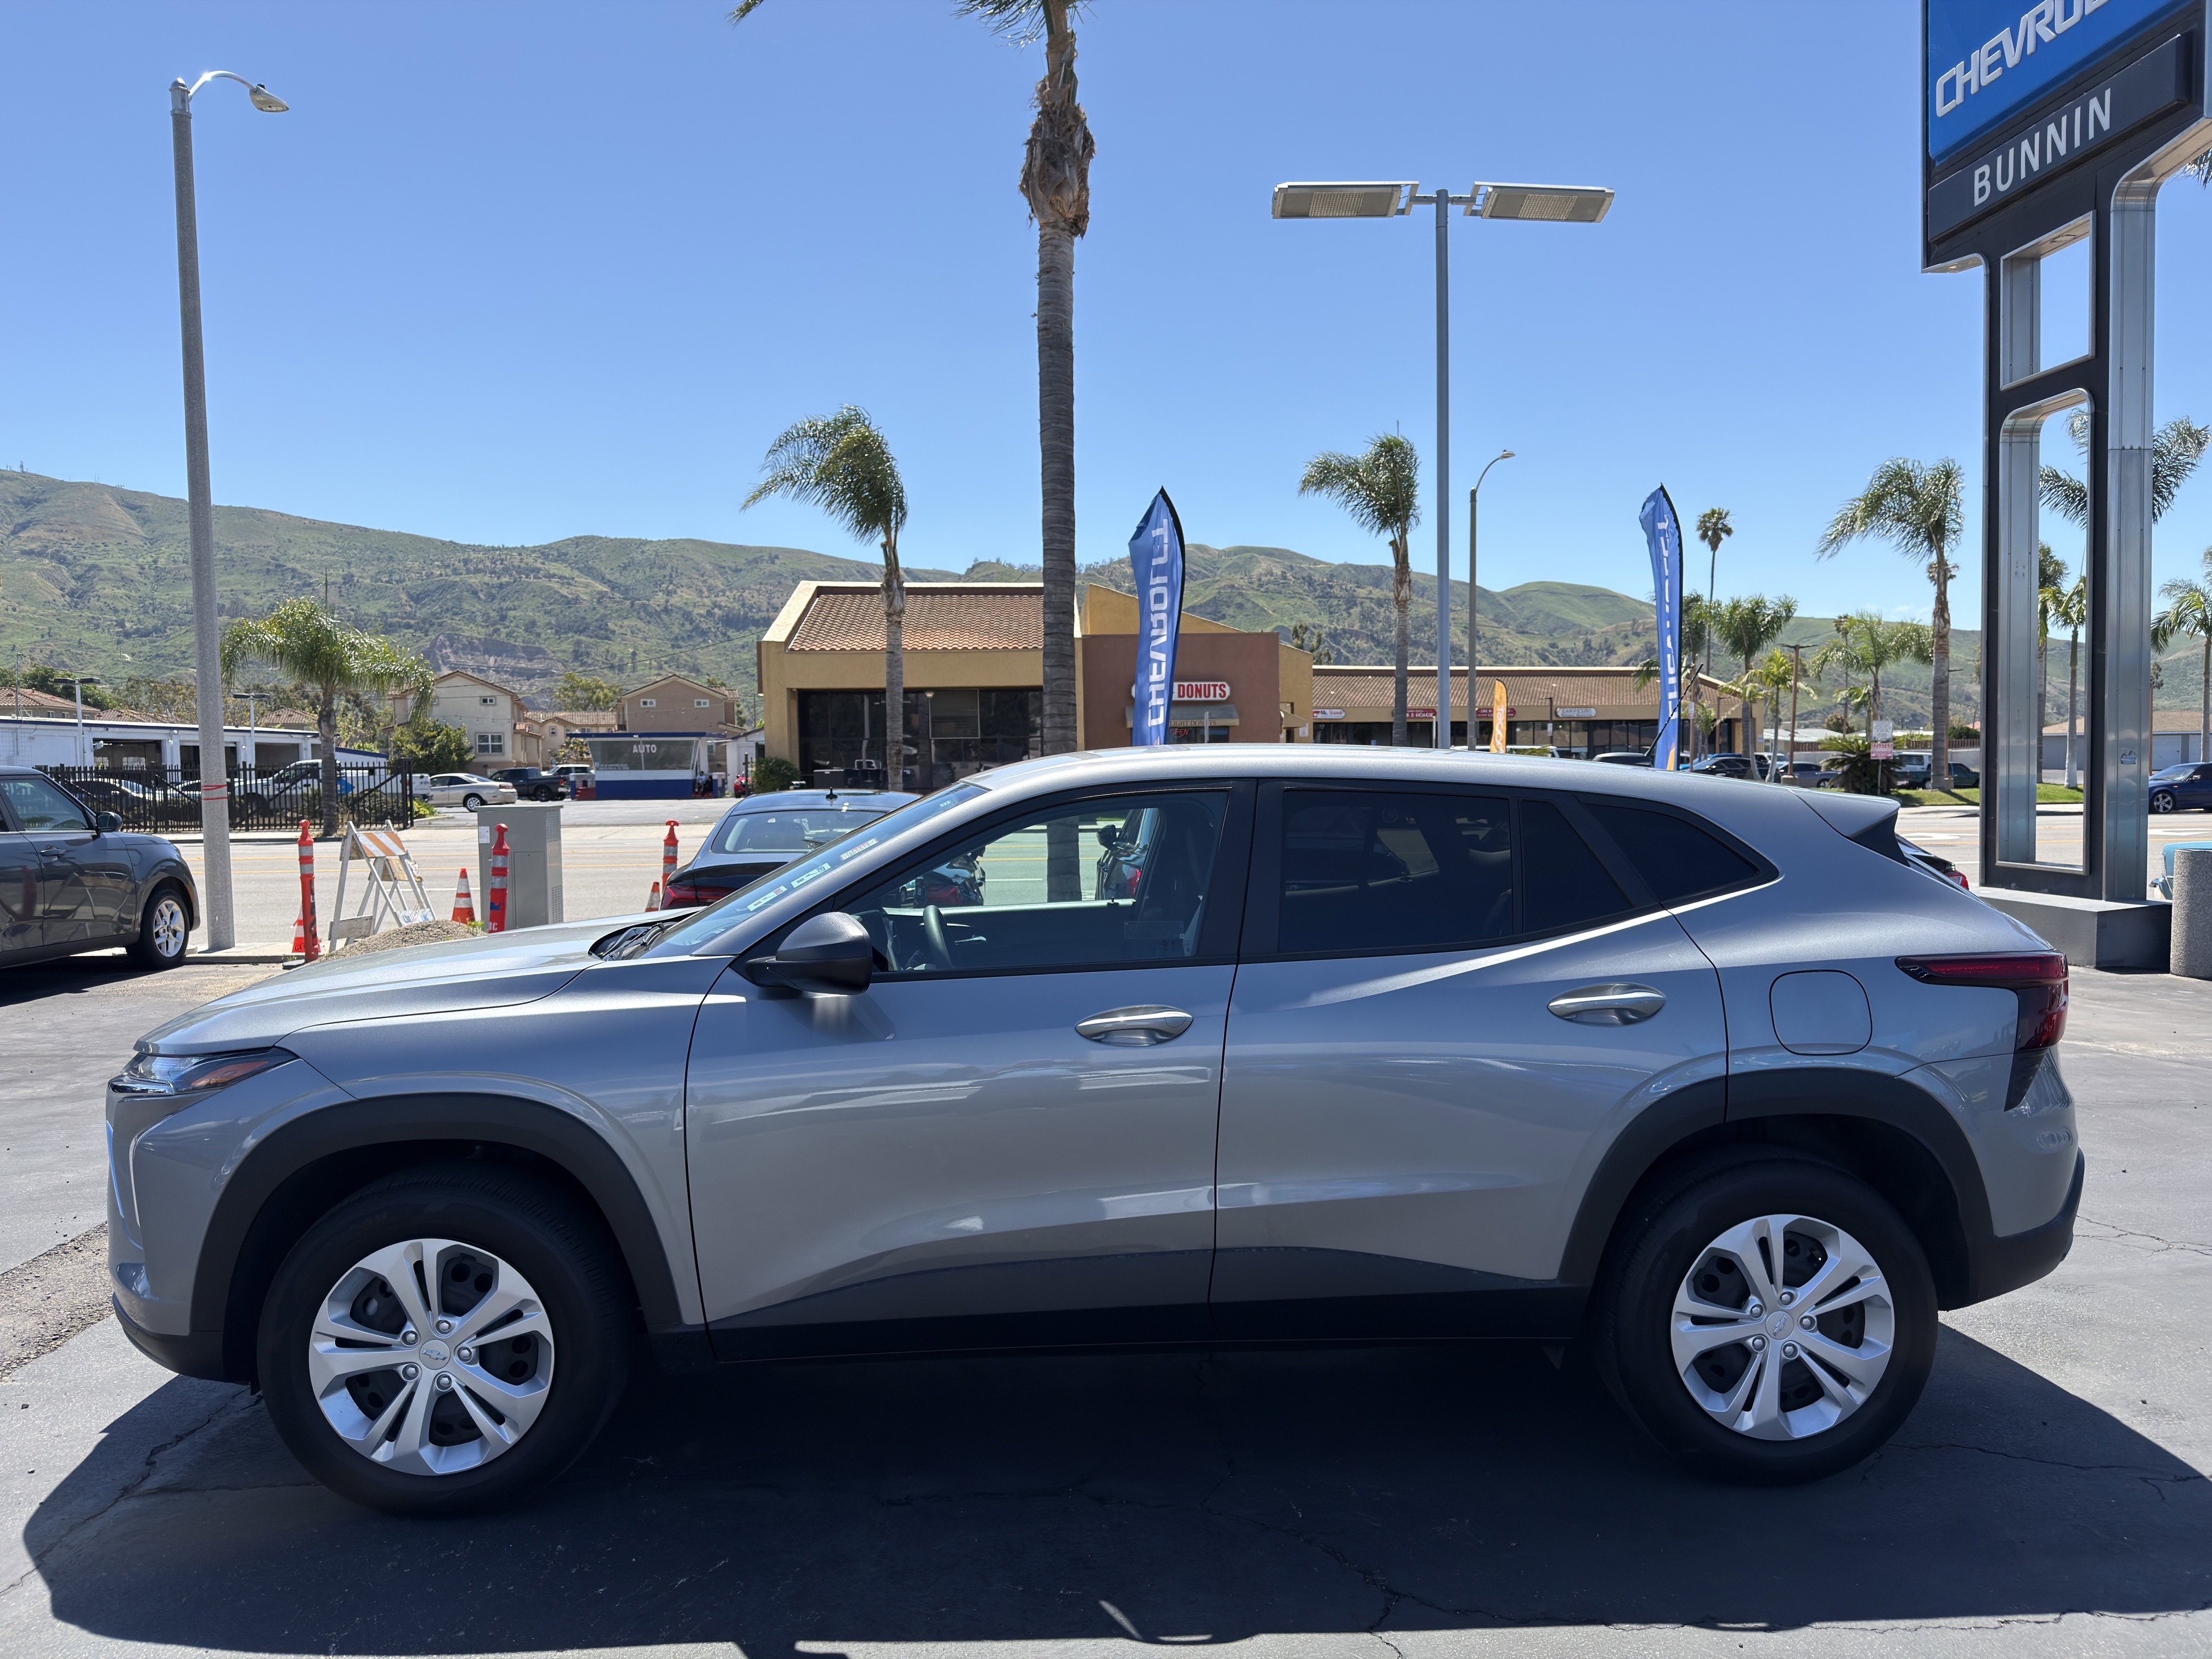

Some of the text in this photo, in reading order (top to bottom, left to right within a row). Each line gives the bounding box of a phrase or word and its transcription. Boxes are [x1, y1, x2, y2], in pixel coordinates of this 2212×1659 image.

[1974, 88, 2111, 207] BUNNIN
[1177, 684, 1226, 698] DONUTS
[633, 744, 657, 753] AUTO
